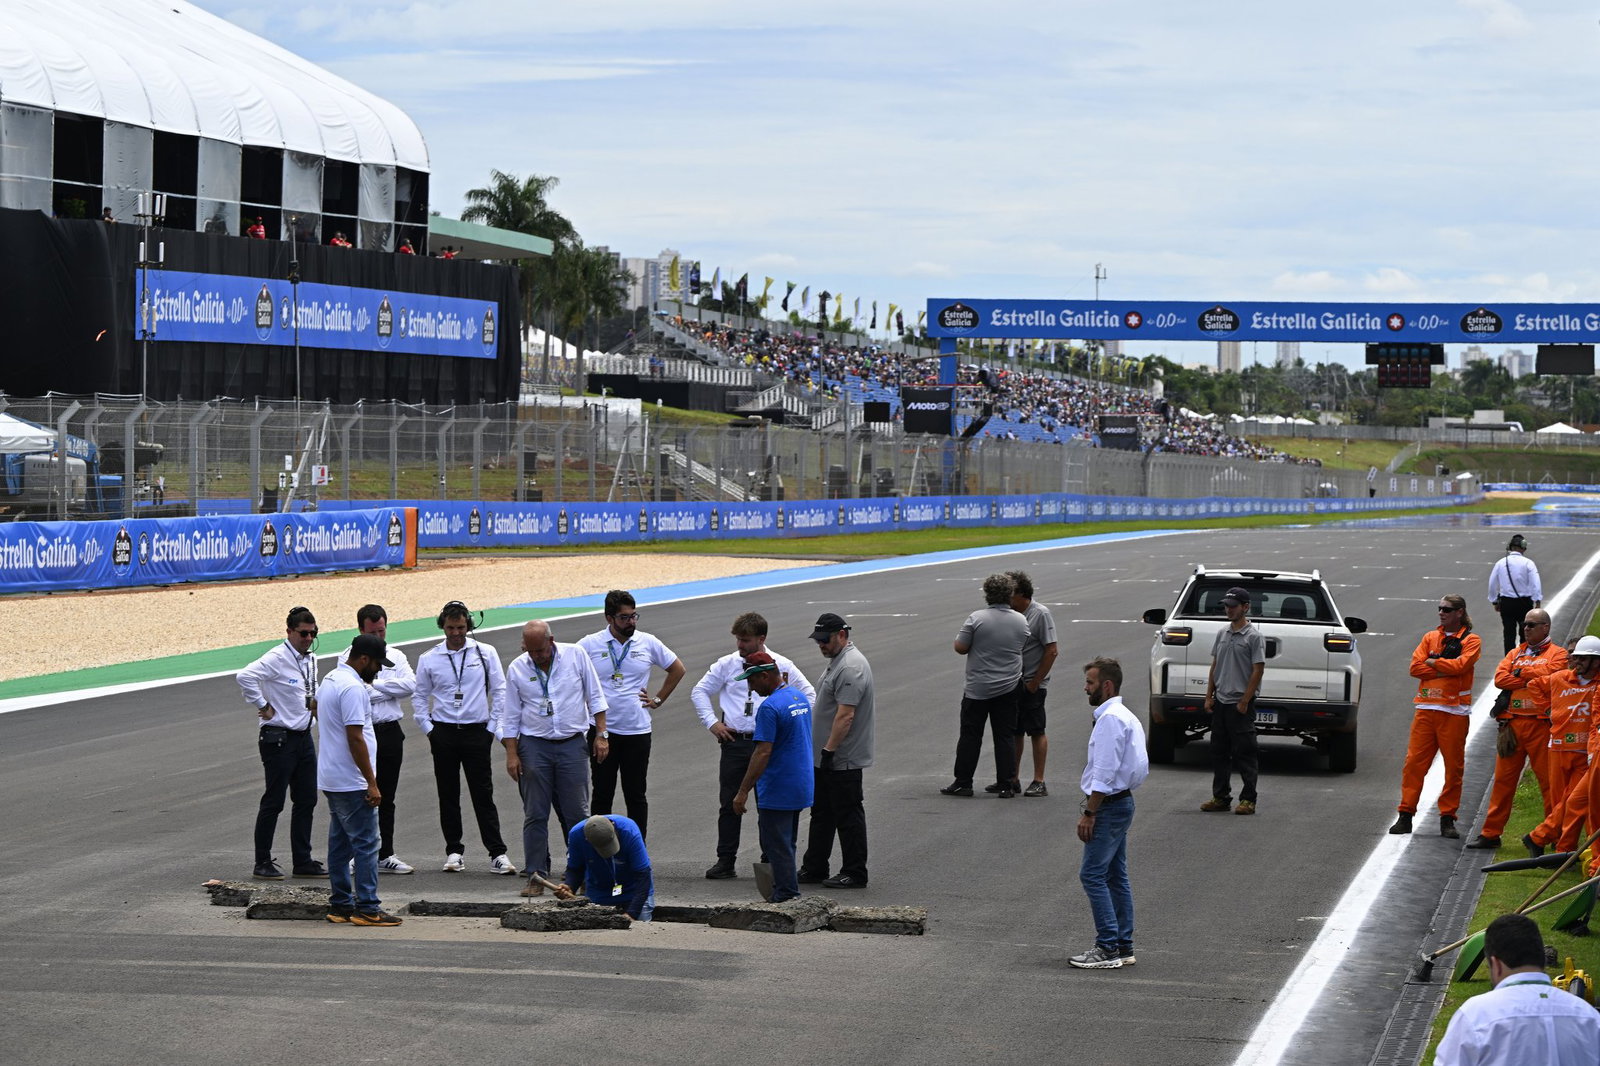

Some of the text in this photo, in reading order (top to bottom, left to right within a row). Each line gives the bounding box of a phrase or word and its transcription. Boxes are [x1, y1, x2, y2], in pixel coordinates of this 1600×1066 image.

[154, 288, 191, 323] Estrella
[192, 290, 225, 324] Galicia
[944, 310, 973, 319] Estrella
[324, 301, 352, 332] Galicia
[408, 310, 436, 338] Estrella
[437, 311, 461, 340] Galicia
[944, 319, 972, 327] Galicia
[990, 309, 1177, 328] Estrella Galicia 0,0
[1204, 313, 1233, 322] Estrella
[1204, 321, 1232, 330] Galicia
[1250, 311, 1440, 331] Estrella Galicia 0,0
[1467, 315, 1496, 324] Estrella
[1514, 313, 1581, 331] Estrella
[1467, 323, 1495, 332] Galicia
[907, 402, 950, 410] MotoGP
[424, 511, 448, 535] Galicia
[152, 531, 191, 563] Estrella
[191, 529, 229, 561] Galicia
[293, 525, 330, 554] Estrella
[331, 522, 361, 552] Galicia
[0, 537, 34, 570] strella
[36, 535, 77, 569] Galicia
[791, 707, 808, 717] STAFF
